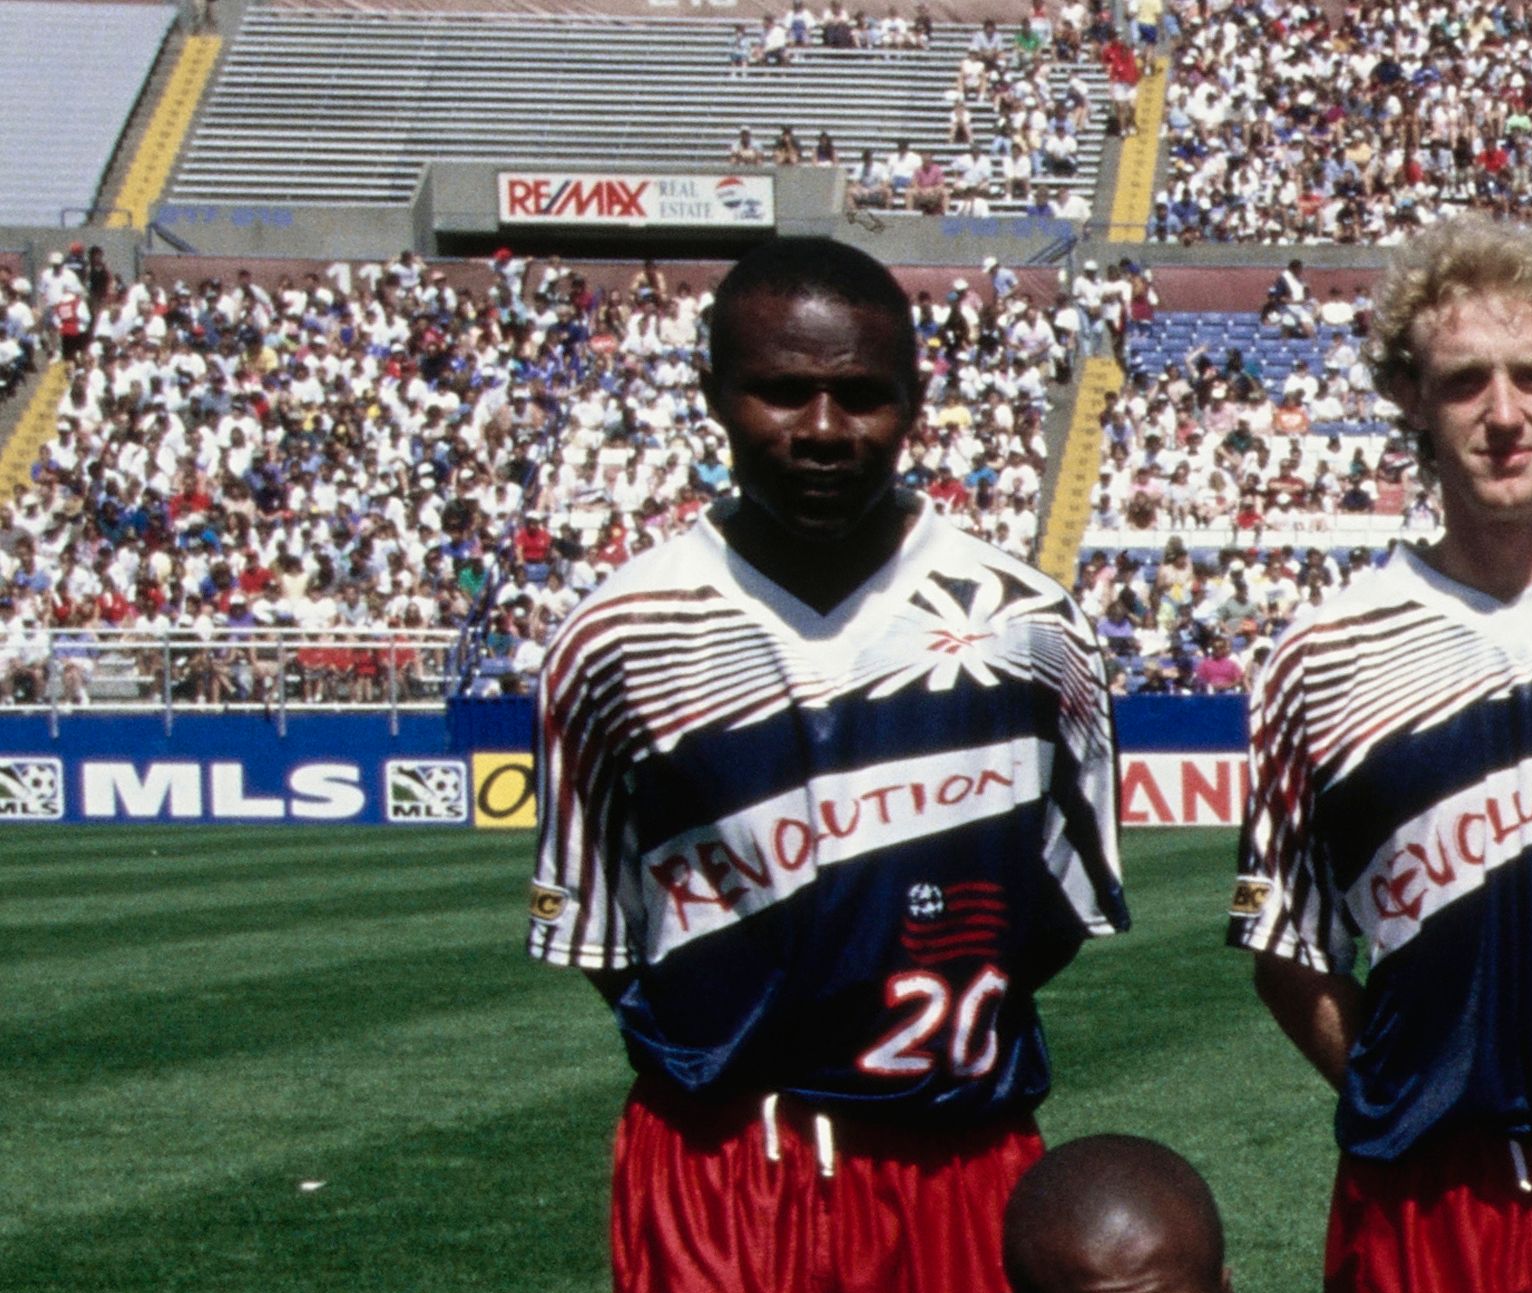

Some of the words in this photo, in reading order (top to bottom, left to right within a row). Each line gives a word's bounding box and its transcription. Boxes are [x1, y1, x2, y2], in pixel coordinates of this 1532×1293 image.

[508, 180, 651, 217] RE/MAX
[658, 181, 698, 198] REAL
[660, 202, 712, 218] ESTATE
[83, 763, 365, 819] MLS
[392, 803, 463, 817] MLS
[651, 769, 1016, 931] REVOLUTION
[856, 963, 1007, 1077] 20
